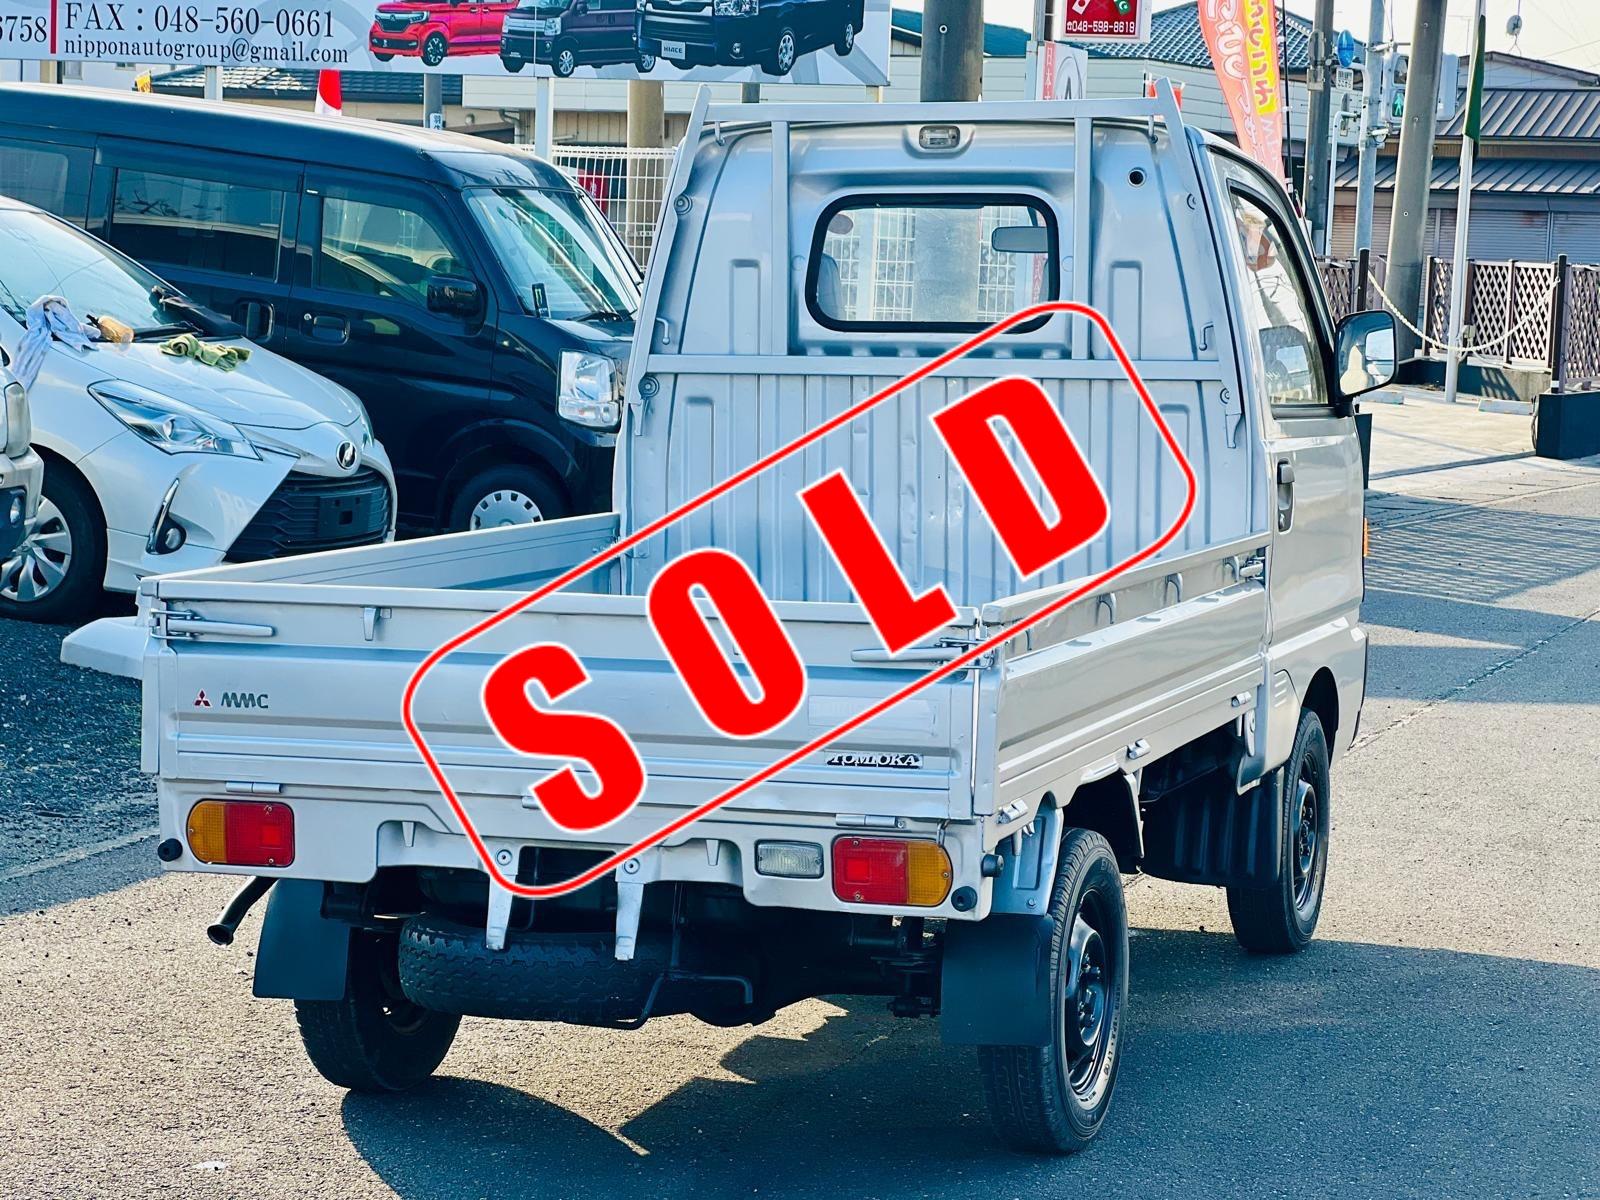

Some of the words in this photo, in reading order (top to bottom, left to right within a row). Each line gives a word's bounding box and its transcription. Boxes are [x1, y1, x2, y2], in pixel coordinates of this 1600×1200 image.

[154, 4, 335, 38] 048-560-0661
[64, 34, 349, 64] nipponautogroup@gmail.com
[221, 692, 269, 709] MMC
